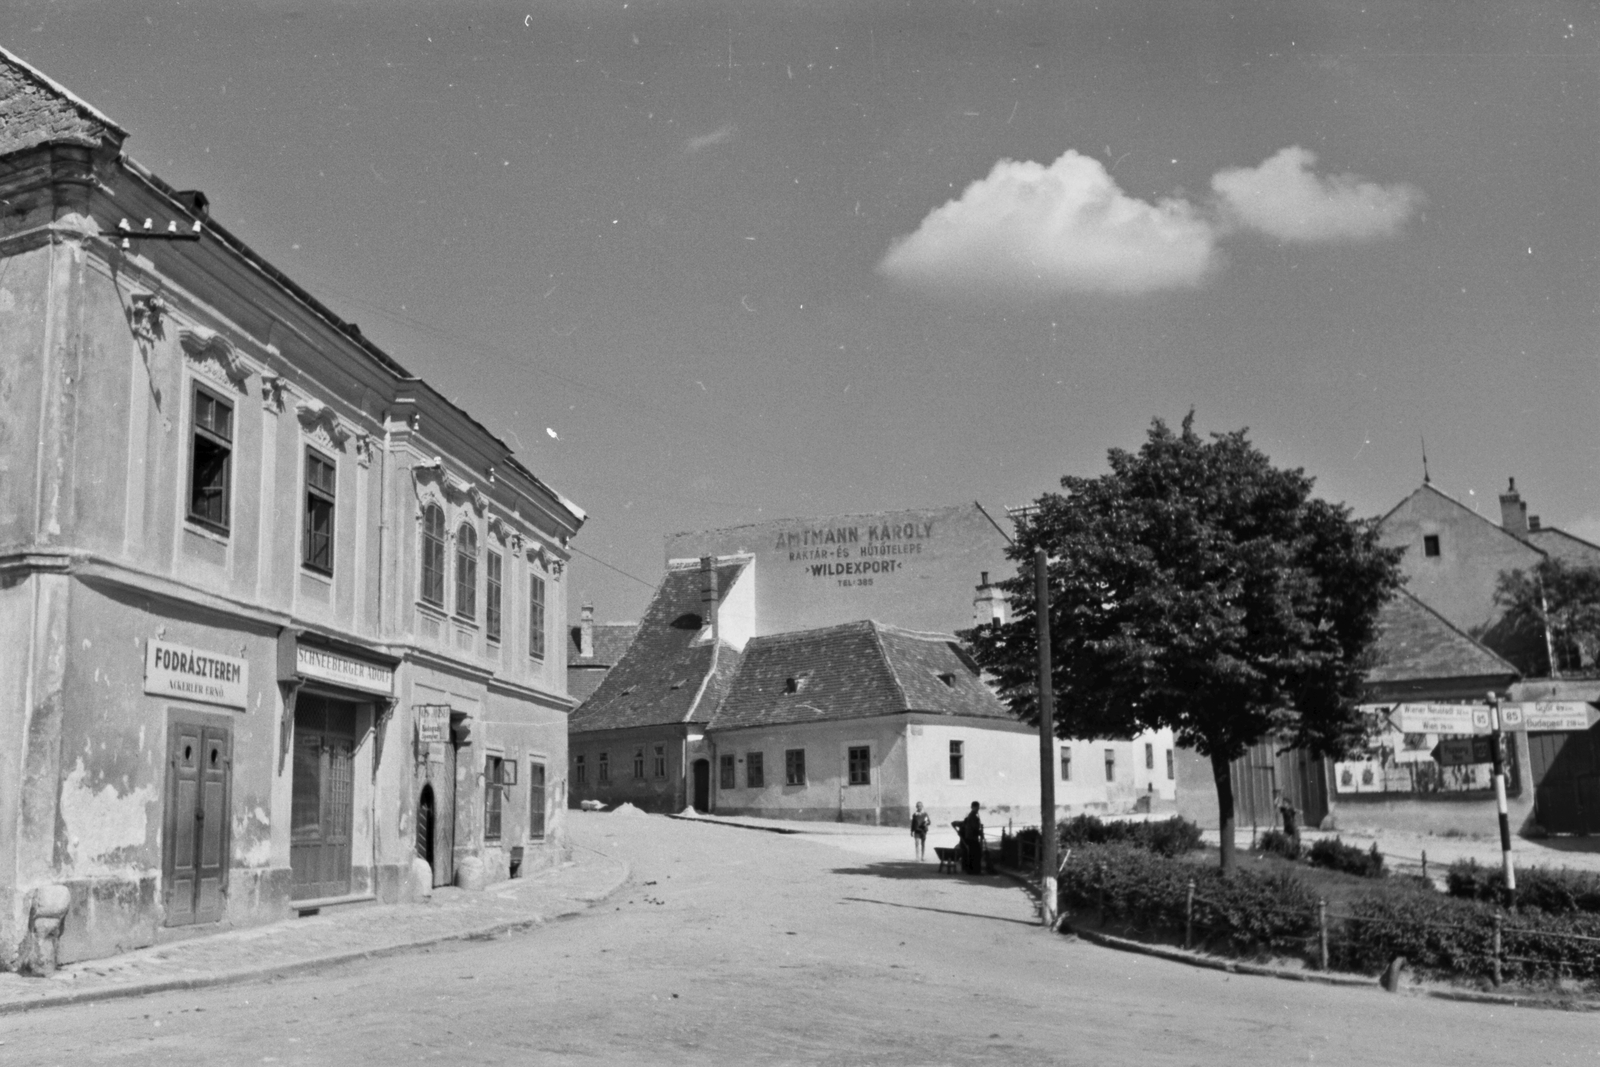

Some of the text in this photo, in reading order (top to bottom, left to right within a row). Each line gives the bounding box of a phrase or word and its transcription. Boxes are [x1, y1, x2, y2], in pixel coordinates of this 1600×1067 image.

[775, 520, 933, 549] AMTMANN KÁROLY
[155, 647, 241, 683] FODRÁSZTEREM
[298, 650, 364, 678] SCHNEEBERGER
[367, 666, 391, 682] ADOLF
[1404, 704, 1426, 714] Wiener
[1476, 714, 1487, 725] 85
[1505, 711, 1519, 722] 85
[1422, 721, 1439, 730] Wien
[1526, 718, 1563, 729] Budapest
